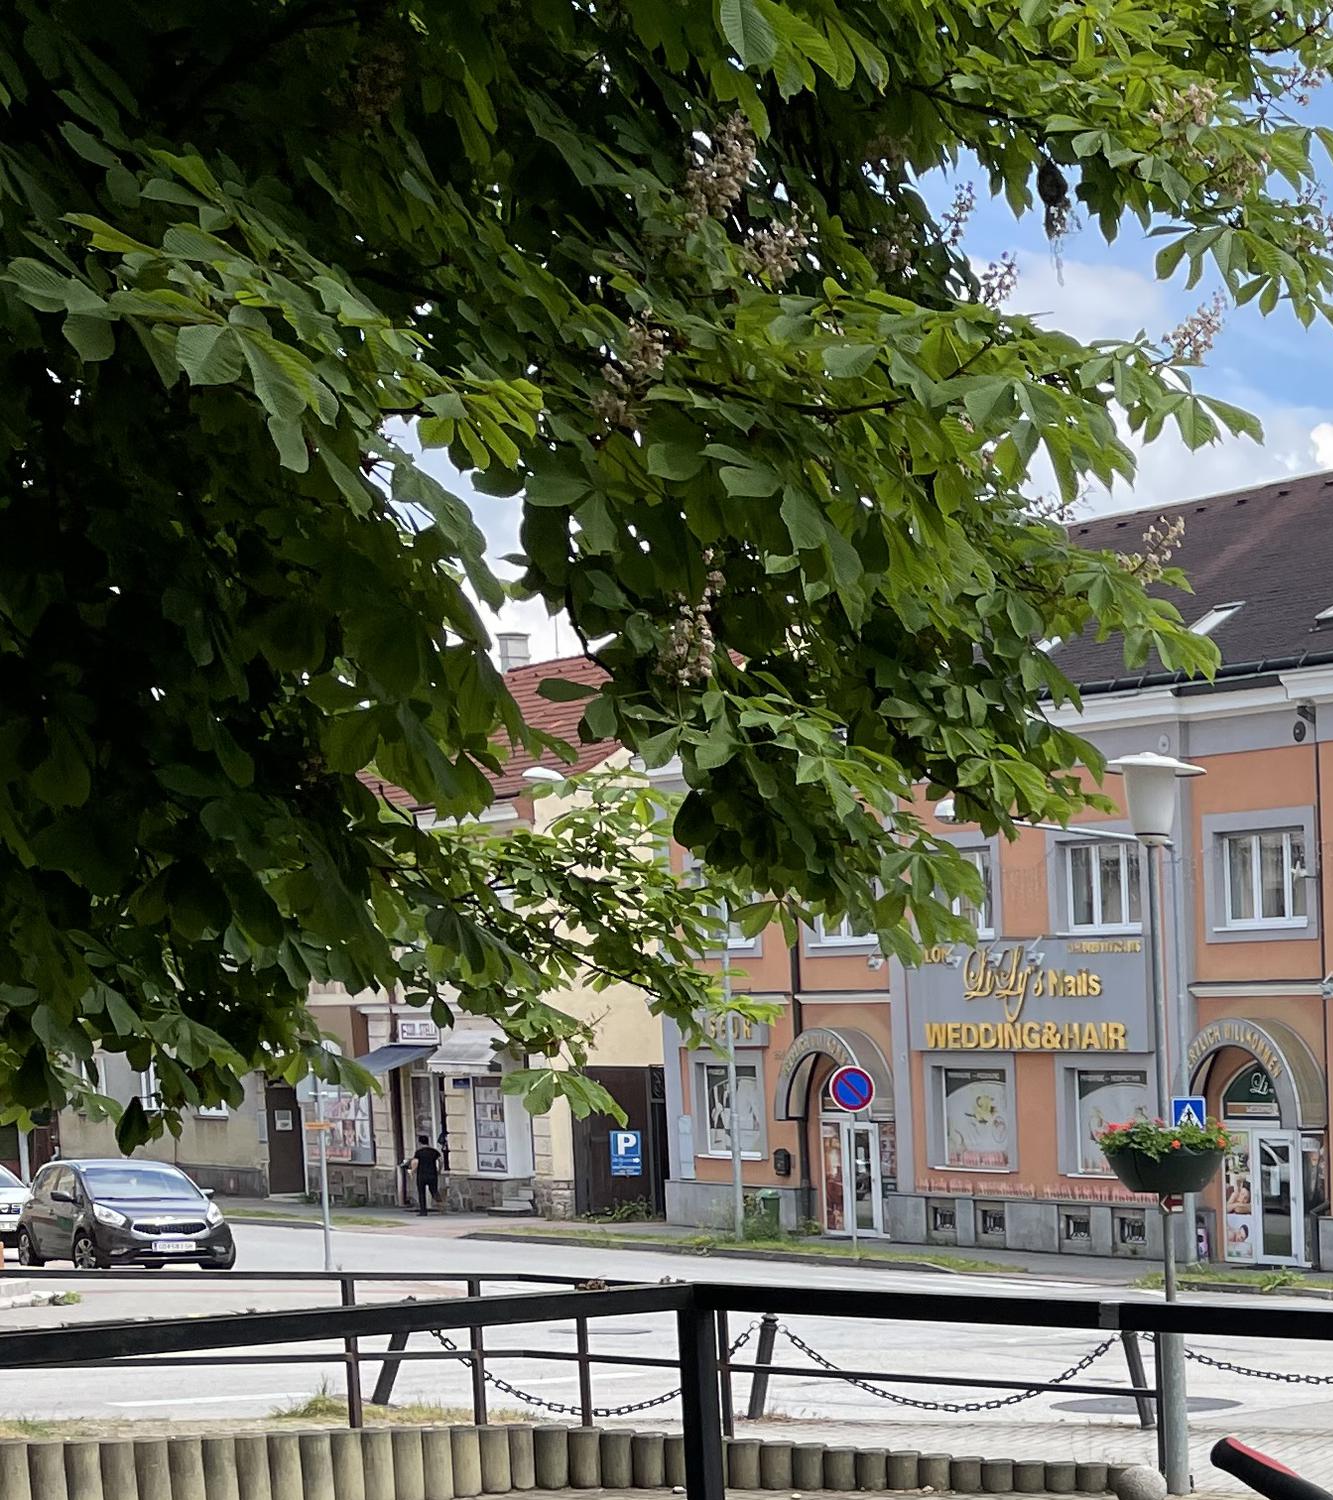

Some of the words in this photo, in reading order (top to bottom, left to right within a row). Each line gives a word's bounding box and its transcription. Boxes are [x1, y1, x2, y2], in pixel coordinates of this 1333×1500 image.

[1048, 967, 1103, 998] Nails
[924, 1021, 1128, 1050] WEDDING&HAIR
[617, 1133, 637, 1156] P
